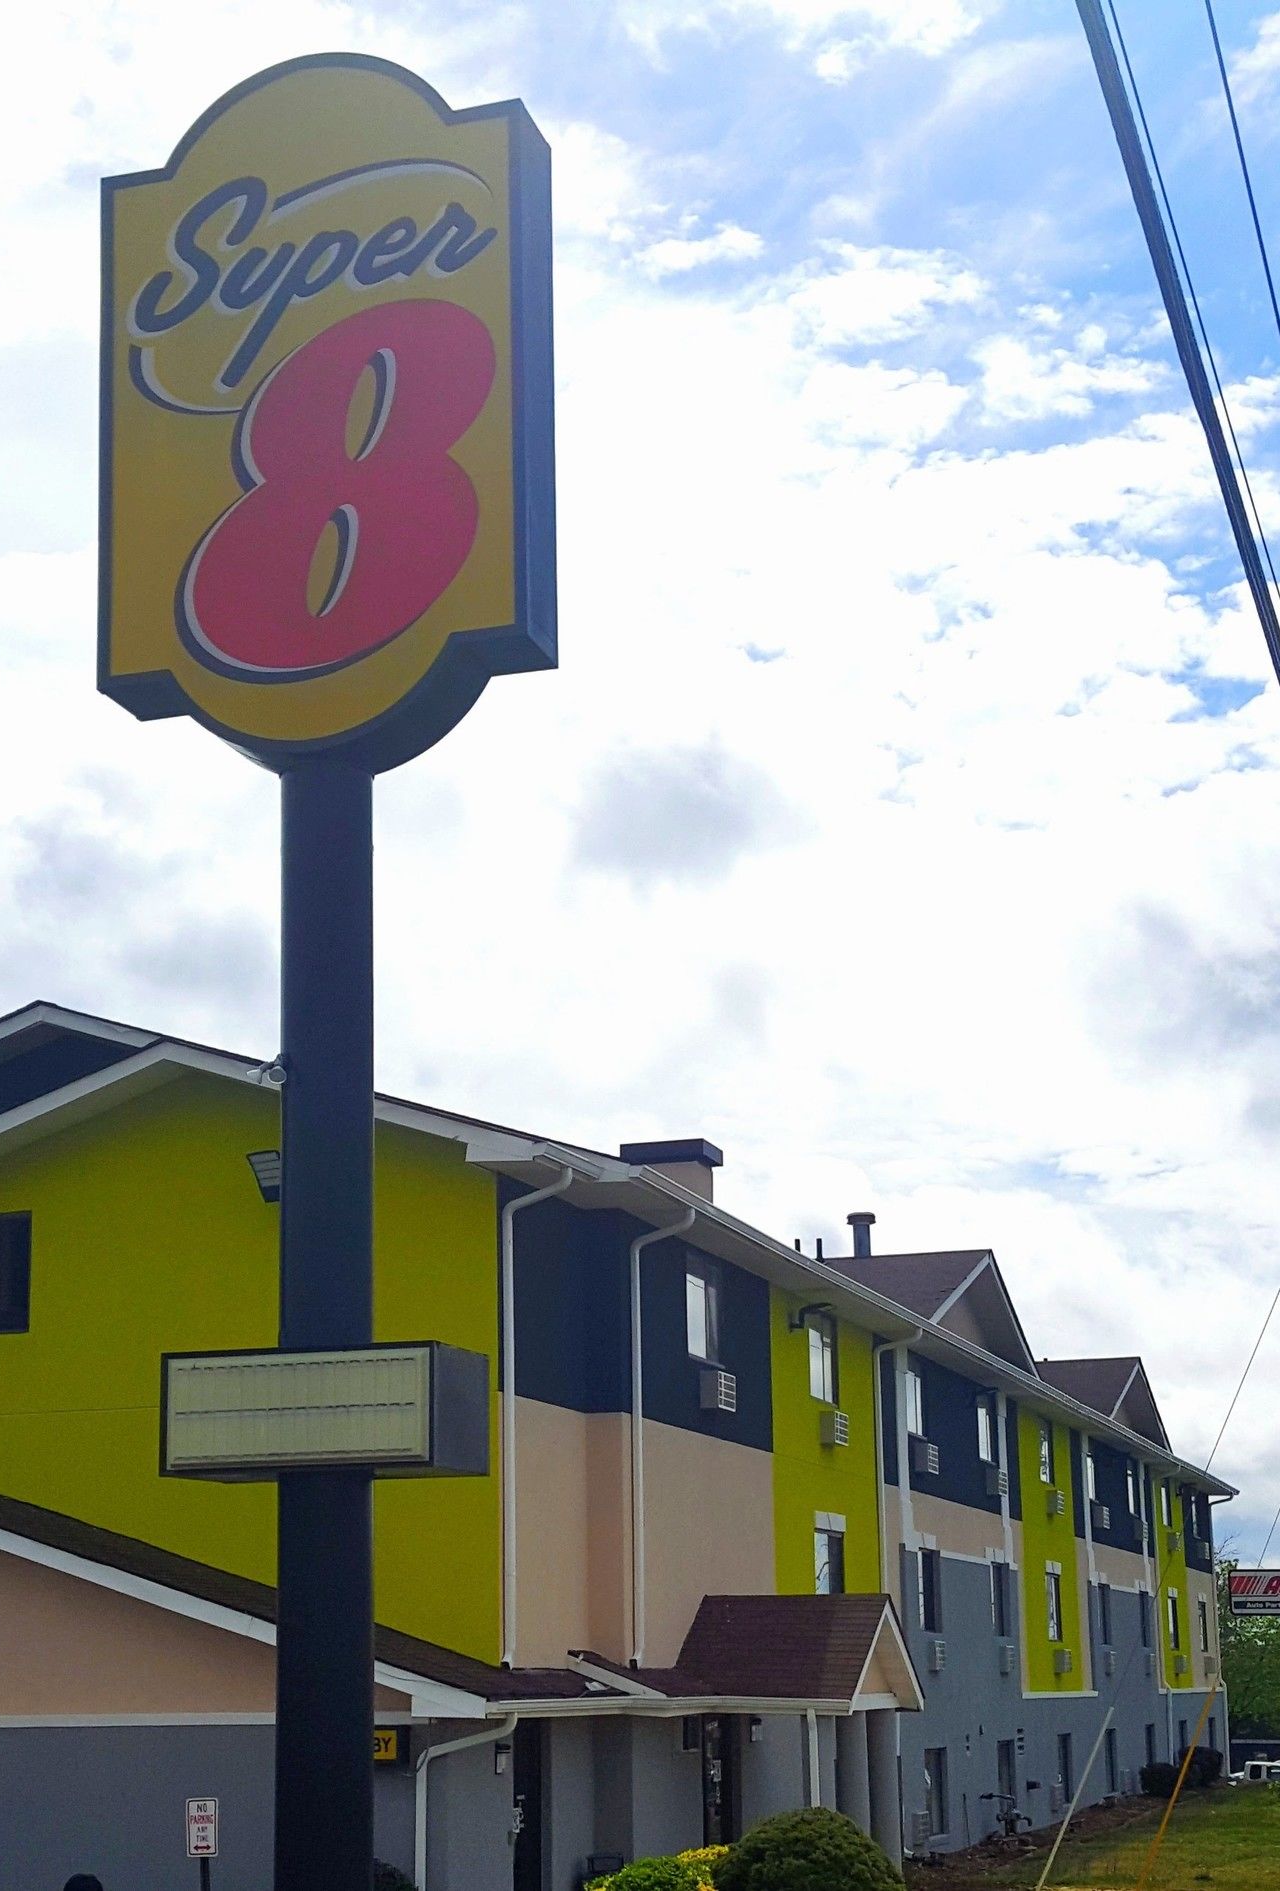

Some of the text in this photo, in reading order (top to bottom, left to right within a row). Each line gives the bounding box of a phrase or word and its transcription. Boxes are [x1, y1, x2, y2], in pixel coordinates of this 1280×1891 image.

[127, 175, 497, 392] Super
[174, 298, 497, 683] 8
[190, 1814, 214, 1825] PARKING
[196, 1803, 208, 1813] NO
